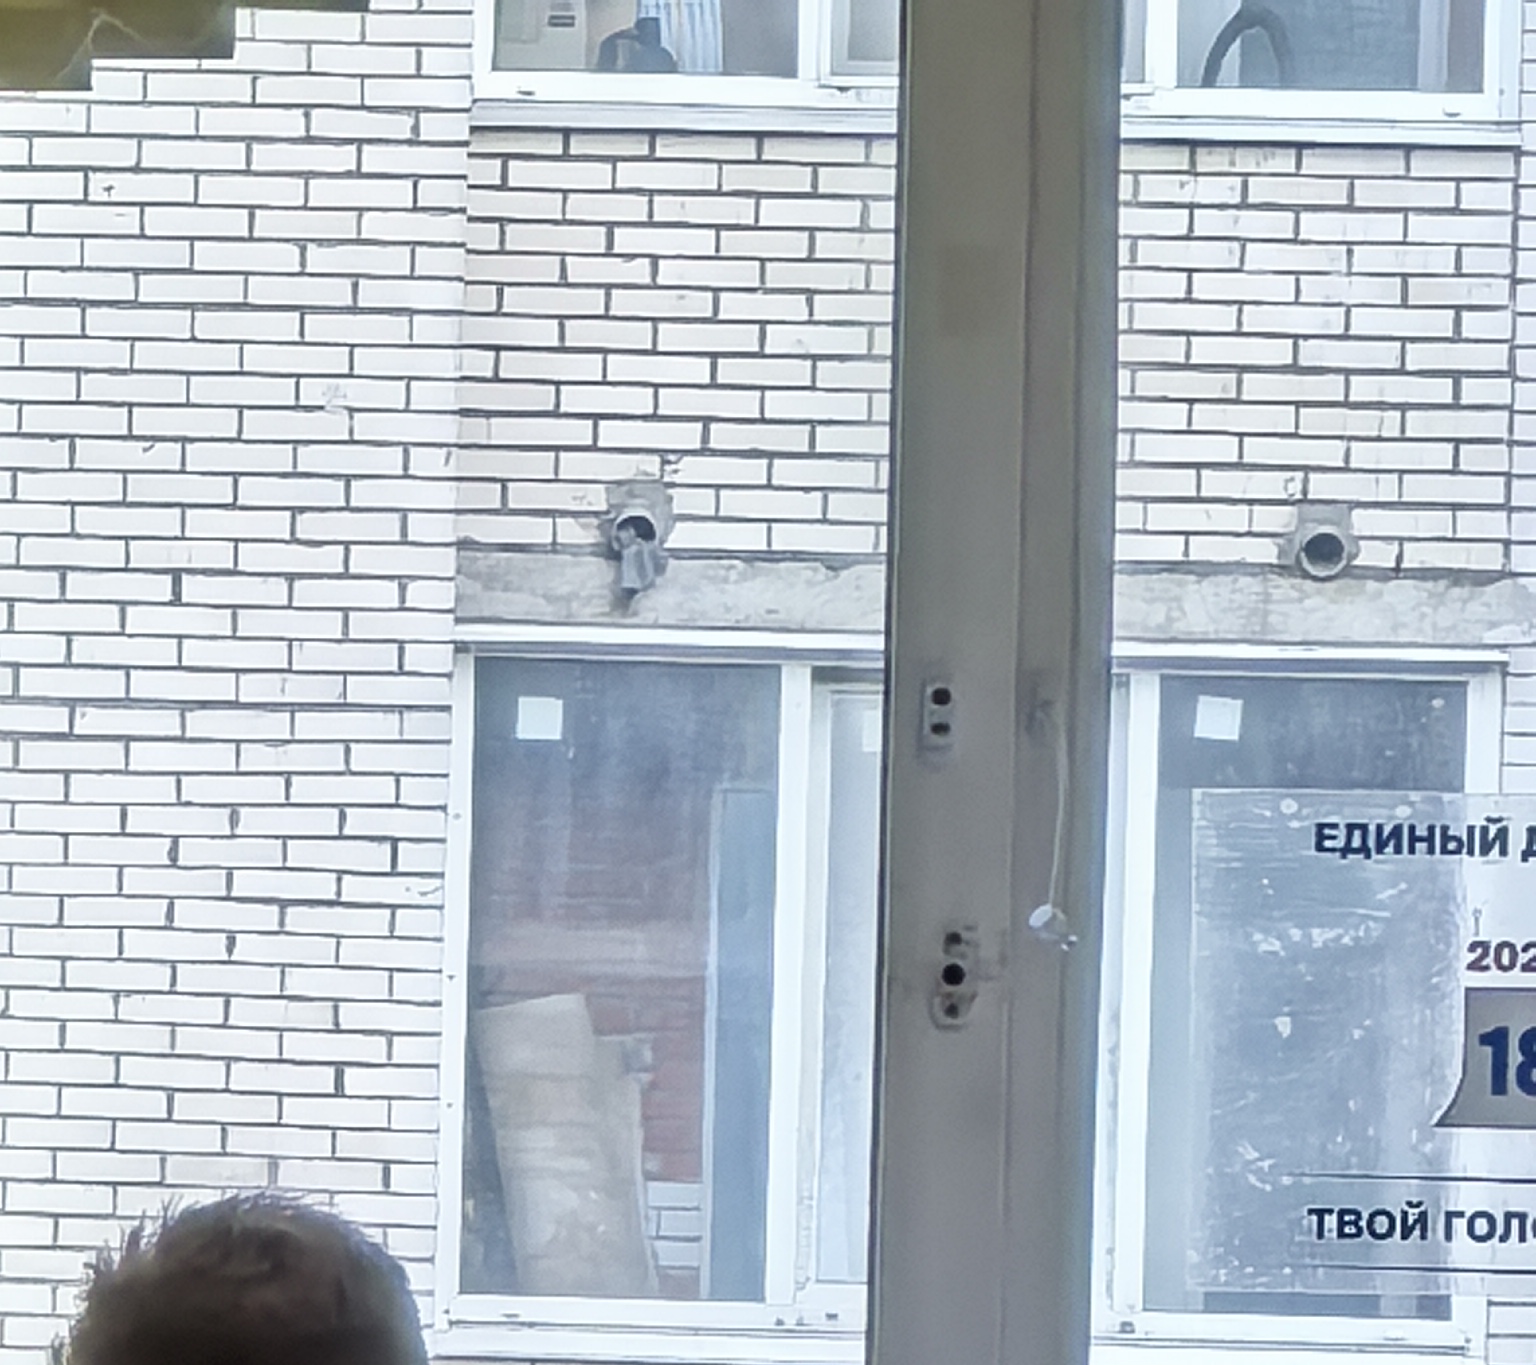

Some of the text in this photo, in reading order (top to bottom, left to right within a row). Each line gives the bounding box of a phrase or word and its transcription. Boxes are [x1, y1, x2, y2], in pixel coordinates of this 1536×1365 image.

[1314, 815, 1509, 861] ЕДИНЫЙ
[1307, 1200, 1536, 1243] ТВОЙ ГОЛ
